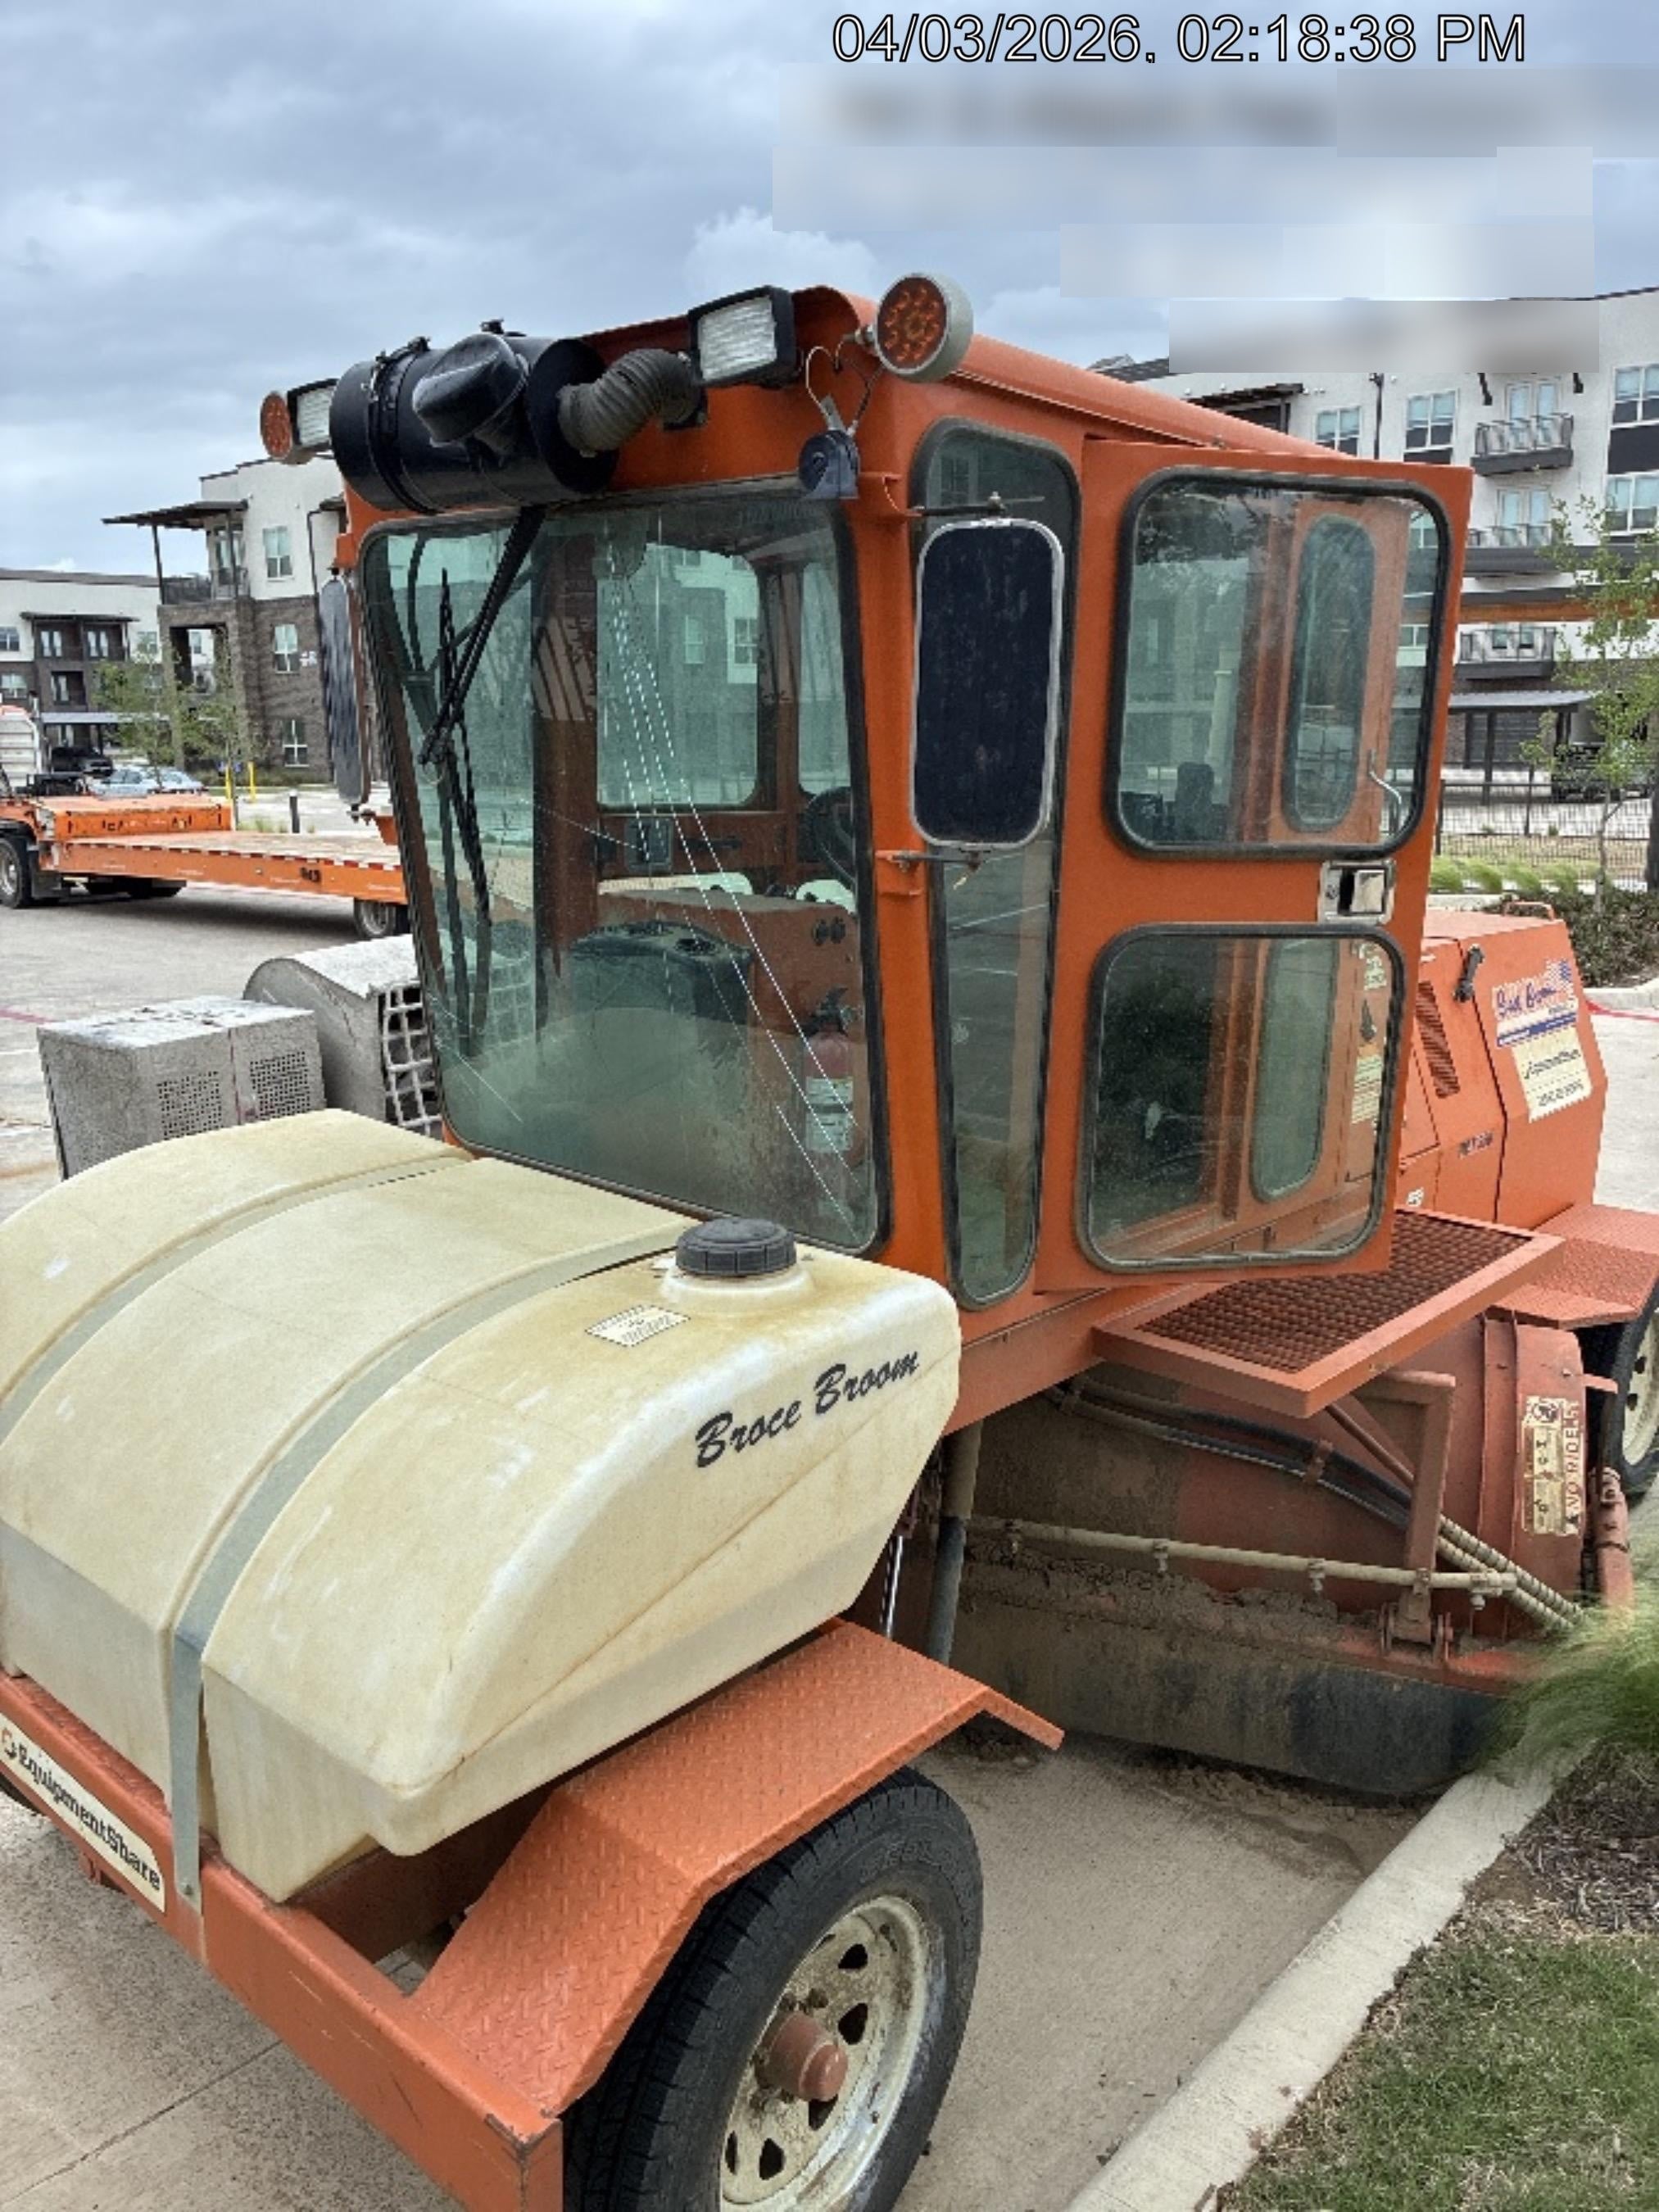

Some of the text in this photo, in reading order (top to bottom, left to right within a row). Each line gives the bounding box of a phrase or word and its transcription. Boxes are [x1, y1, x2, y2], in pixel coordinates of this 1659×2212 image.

[695, 1351, 919, 1468] Broce Broom
[18, 1743, 161, 1891] EquipmentShare
